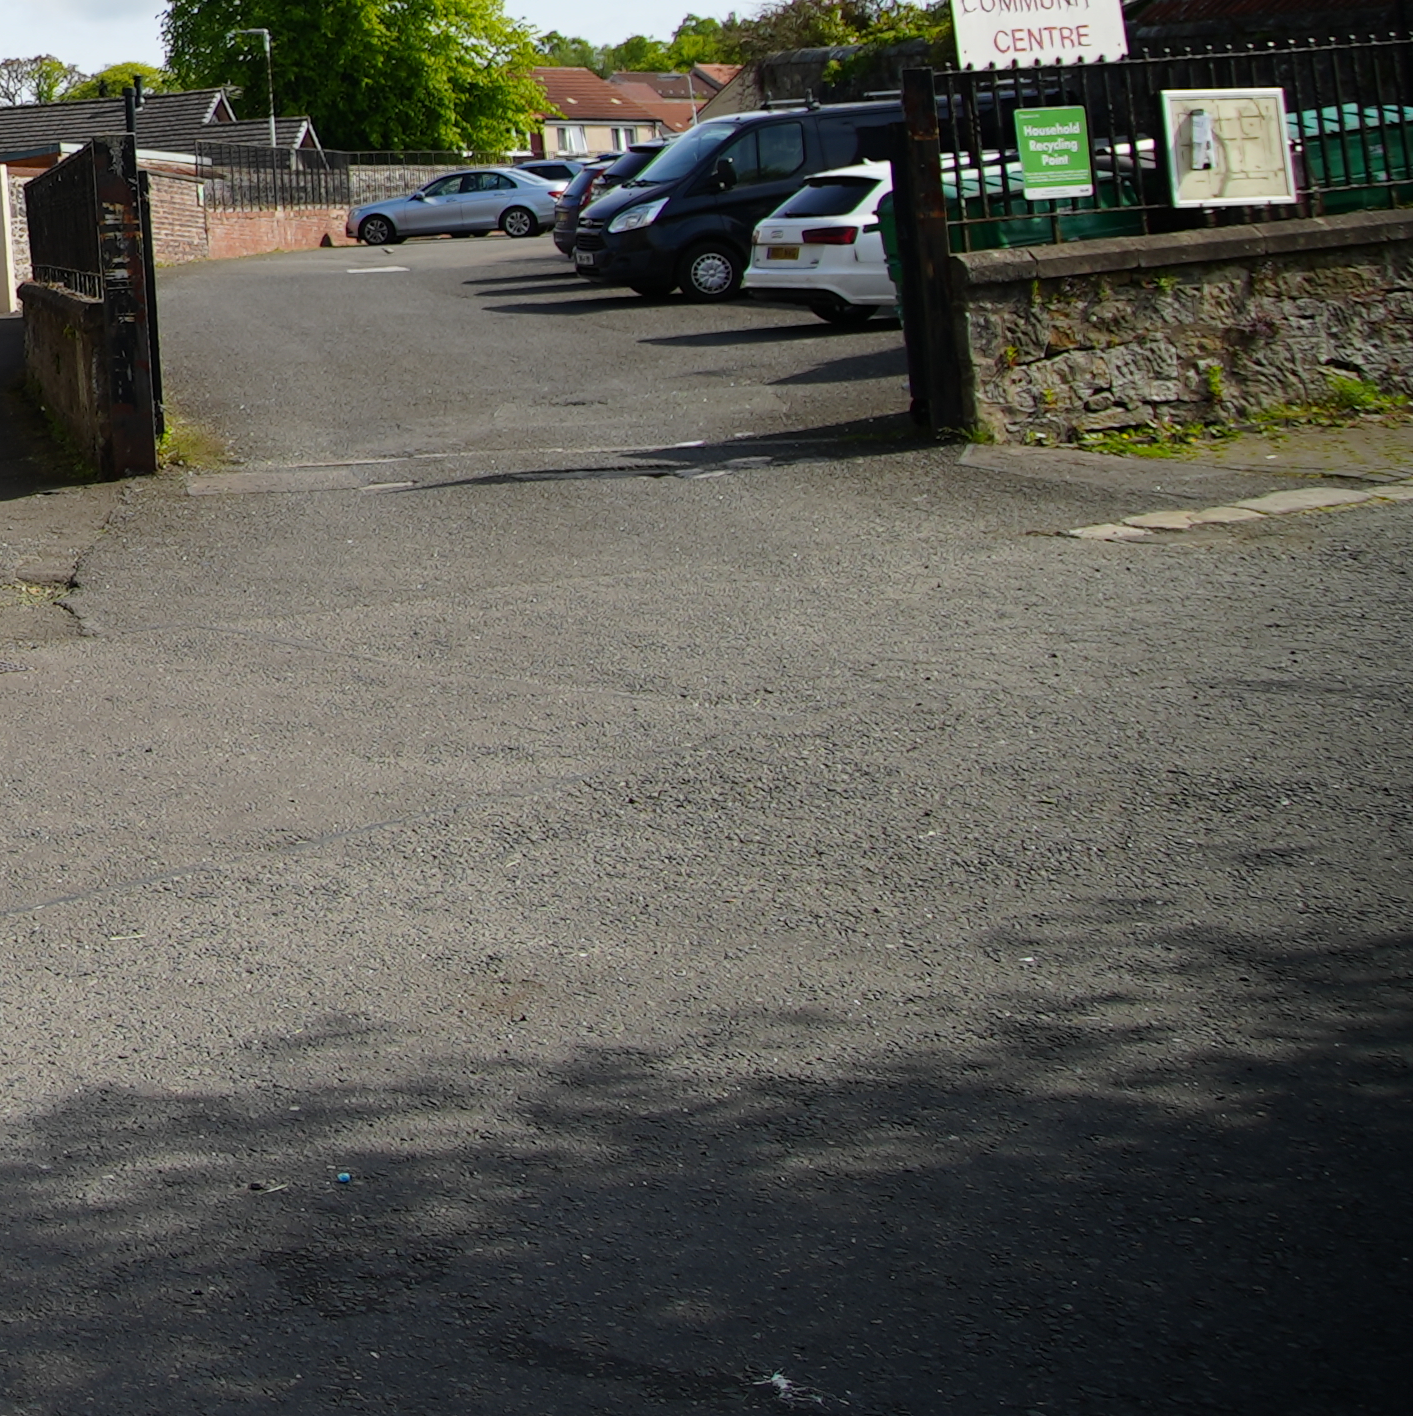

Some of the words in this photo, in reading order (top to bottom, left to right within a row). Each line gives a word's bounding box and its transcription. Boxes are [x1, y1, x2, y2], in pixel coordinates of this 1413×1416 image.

[993, 25, 1092, 54] CENTRE
[1023, 122, 1081, 137] Household
[1029, 138, 1079, 154] Recycling
[1041, 153, 1070, 166] Point
